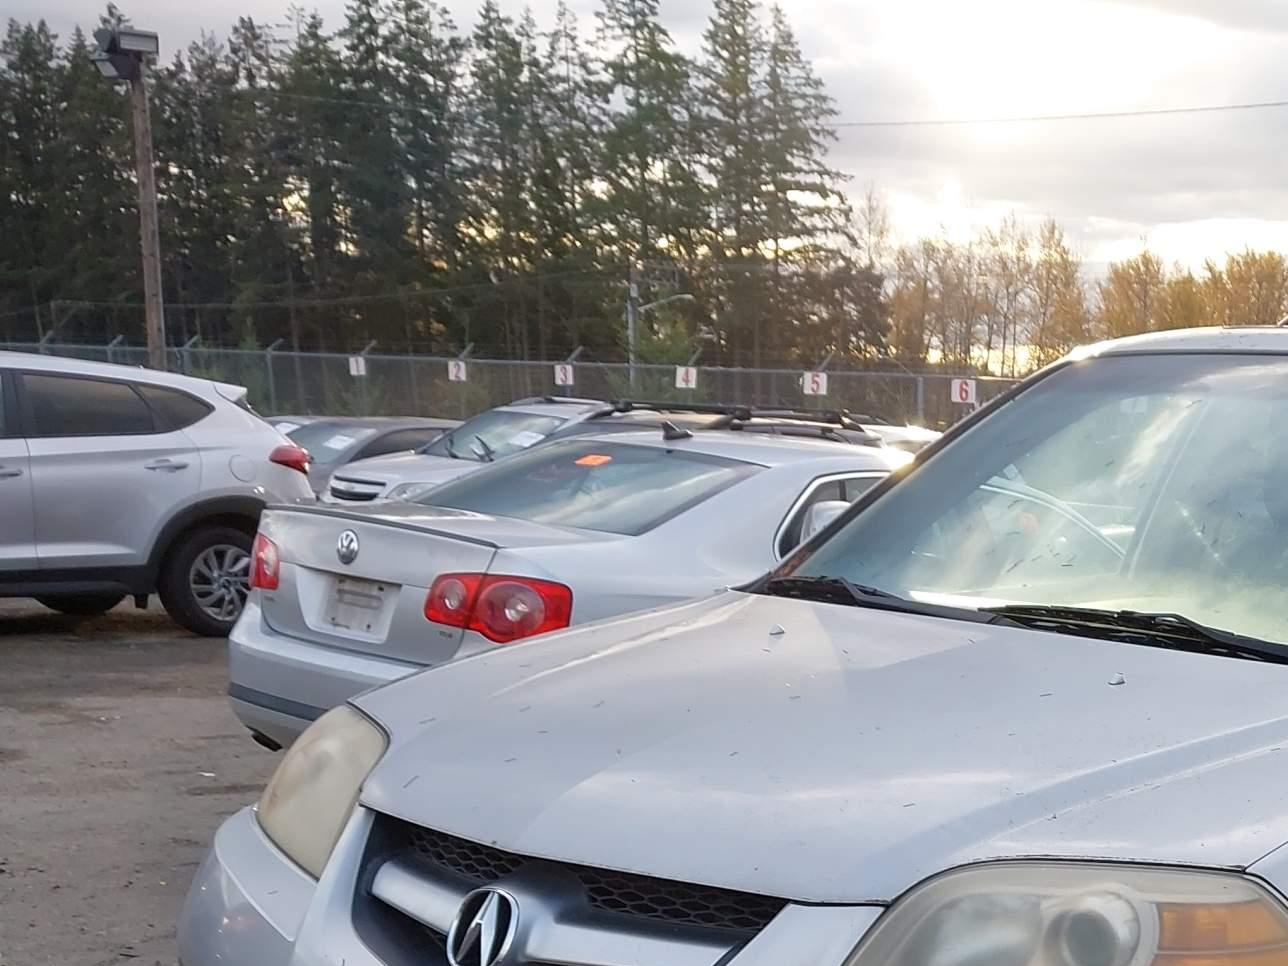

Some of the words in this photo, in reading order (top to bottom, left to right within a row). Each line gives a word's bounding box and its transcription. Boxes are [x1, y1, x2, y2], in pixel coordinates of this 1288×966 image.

[453, 364, 461, 379] 2
[560, 366, 568, 383] 3
[682, 368, 690, 385] 4
[811, 374, 820, 393] 5
[959, 381, 969, 401] 6
